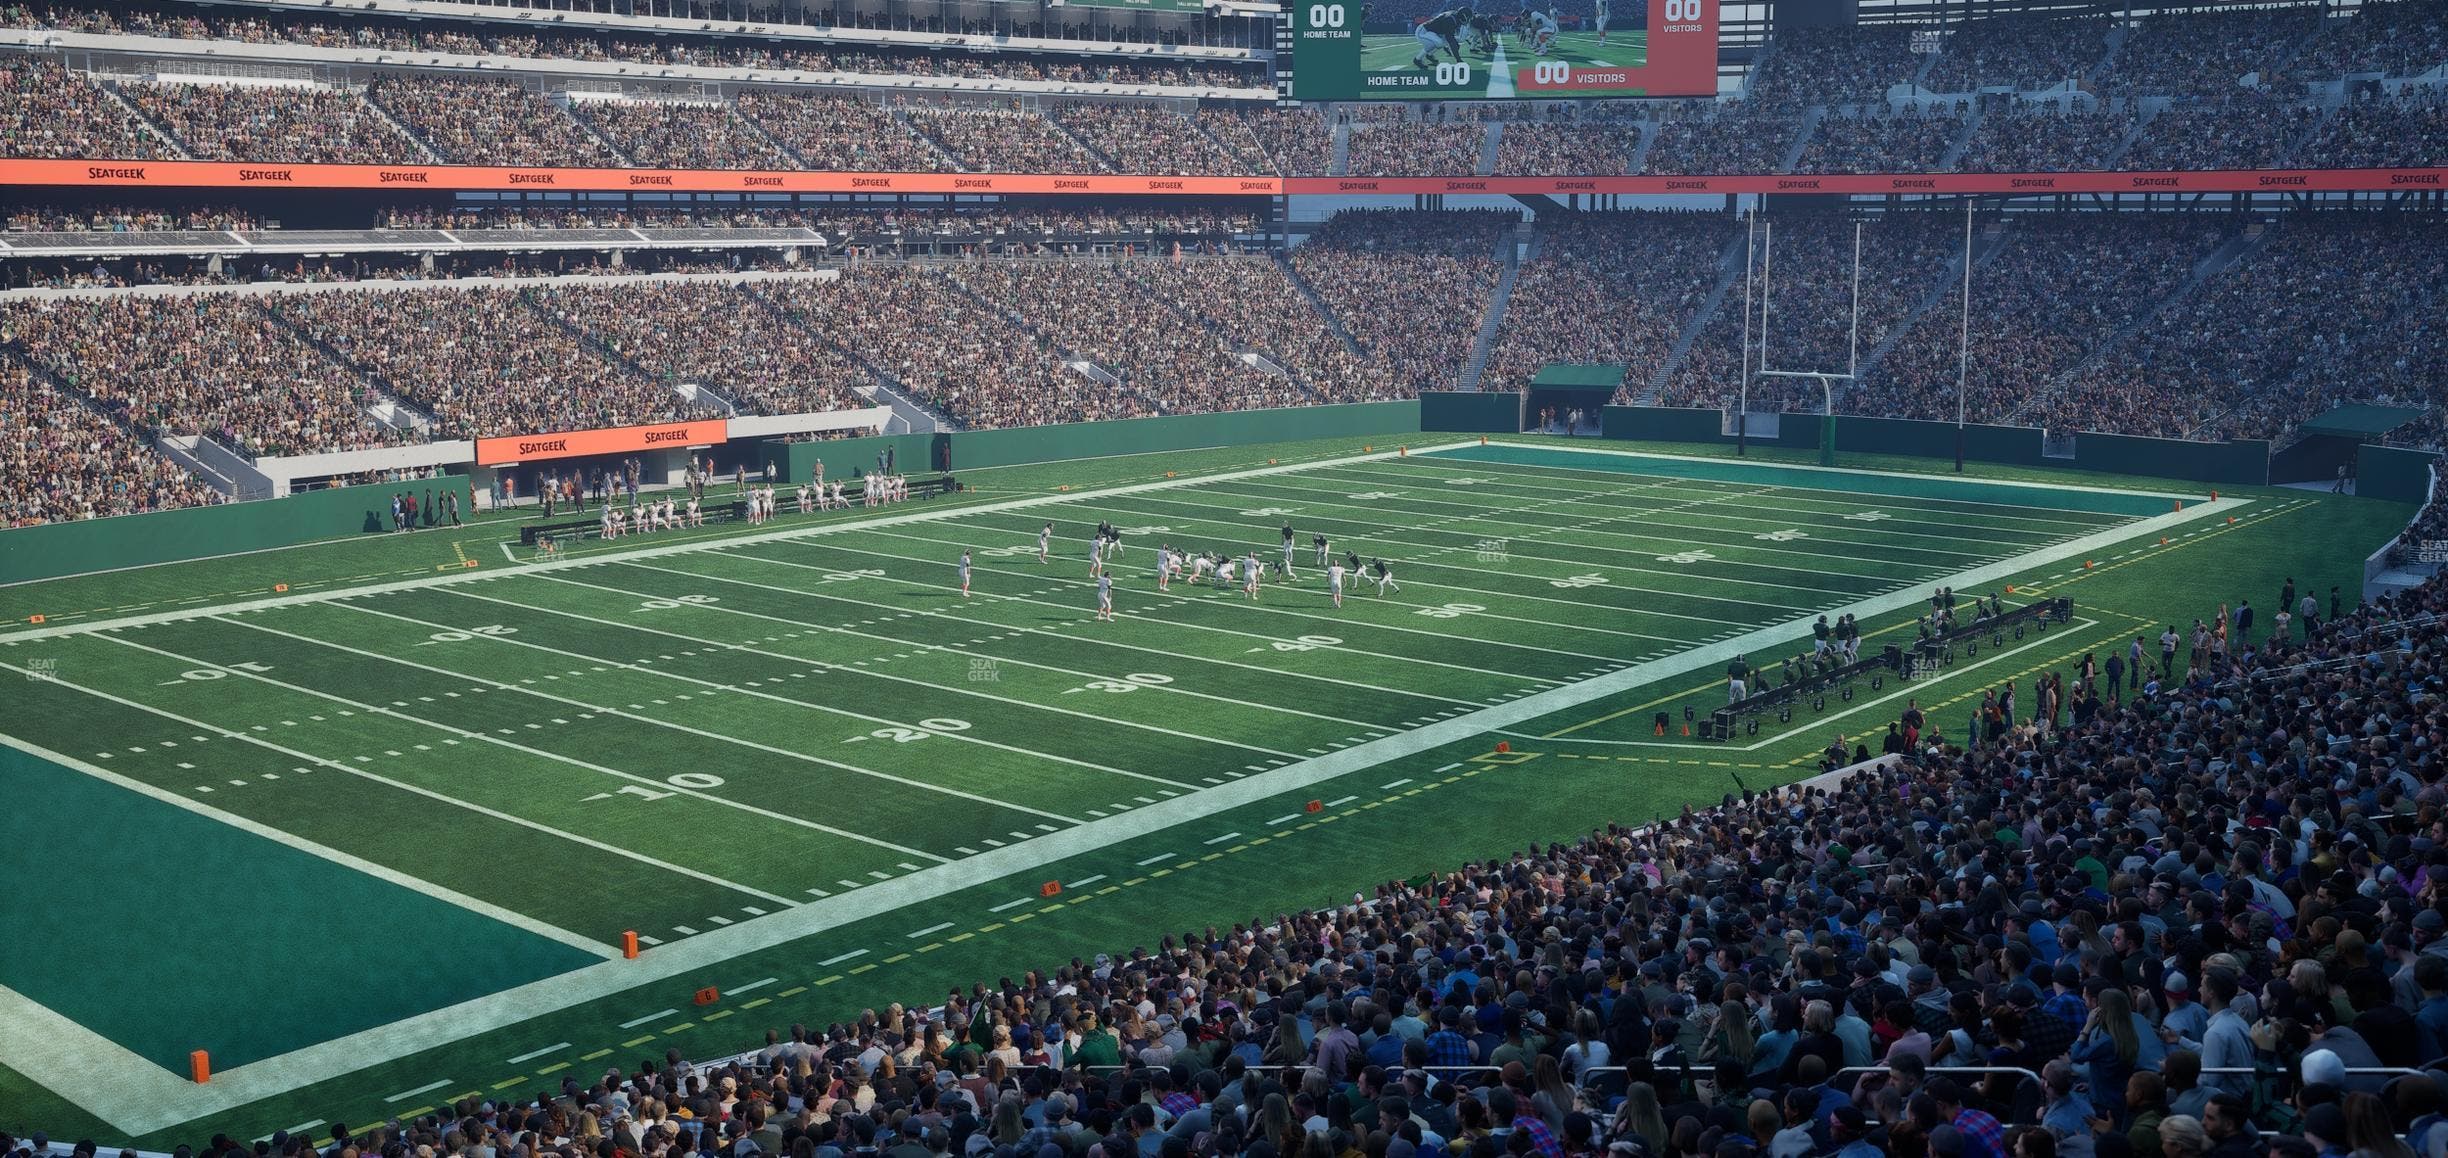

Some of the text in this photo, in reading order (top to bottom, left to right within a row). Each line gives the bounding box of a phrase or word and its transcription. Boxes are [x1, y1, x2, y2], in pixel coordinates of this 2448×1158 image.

[1310, 4, 1344, 27] 00
[1664, 0, 1700, 21] 00
[1303, 30, 1351, 38] HOME TEAM
[1663, 24, 1702, 32] VISITORS
[1367, 62, 1470, 86] HOME TEAM 00
[1535, 61, 1626, 84] 00 VISITORS
[88, 167, 146, 180] SEATGEEK
[239, 169, 293, 182] SEATGEEK
[379, 171, 428, 183] SEATGEEK
[508, 173, 555, 185] SEATGEEK
[2390, 173, 2441, 185] SEATGEEK
[629, 175, 673, 186] SEATGEEK
[743, 176, 784, 187] SEATGEEK
[851, 177, 890, 188] SEATGEEK
[954, 179, 992, 189] SEATGEEK
[1054, 180, 1089, 189] SEATGEEK
[1148, 181, 1183, 190] SEATGEEK
[1240, 181, 1273, 191] SEATGEEK
[1338, 181, 1378, 191] SEATGEEK
[1446, 181, 1487, 191] SEATGEEK
[1555, 181, 1596, 190] SEATGEEK
[1666, 180, 1707, 190] SEATGEEK
[1777, 179, 1820, 189] SEATGEEK
[1892, 179, 1936, 189] SEATGEEK
[2010, 178, 2055, 188] SEATGEEK
[2132, 176, 2180, 187] SEATGEEK
[2258, 175, 2308, 186] SEATGEEK
[645, 429, 688, 444] SEATGEEK
[519, 440, 567, 455] SEATGEEK
[641, 595, 719, 609] 30
[1414, 603, 1487, 618] 50
[430, 624, 518, 642] 20
[1271, 635, 1342, 651] 40
[180, 661, 274, 680] 10
[1084, 673, 1172, 693] 30
[871, 718, 971, 743] 20
[615, 773, 725, 801] 10
